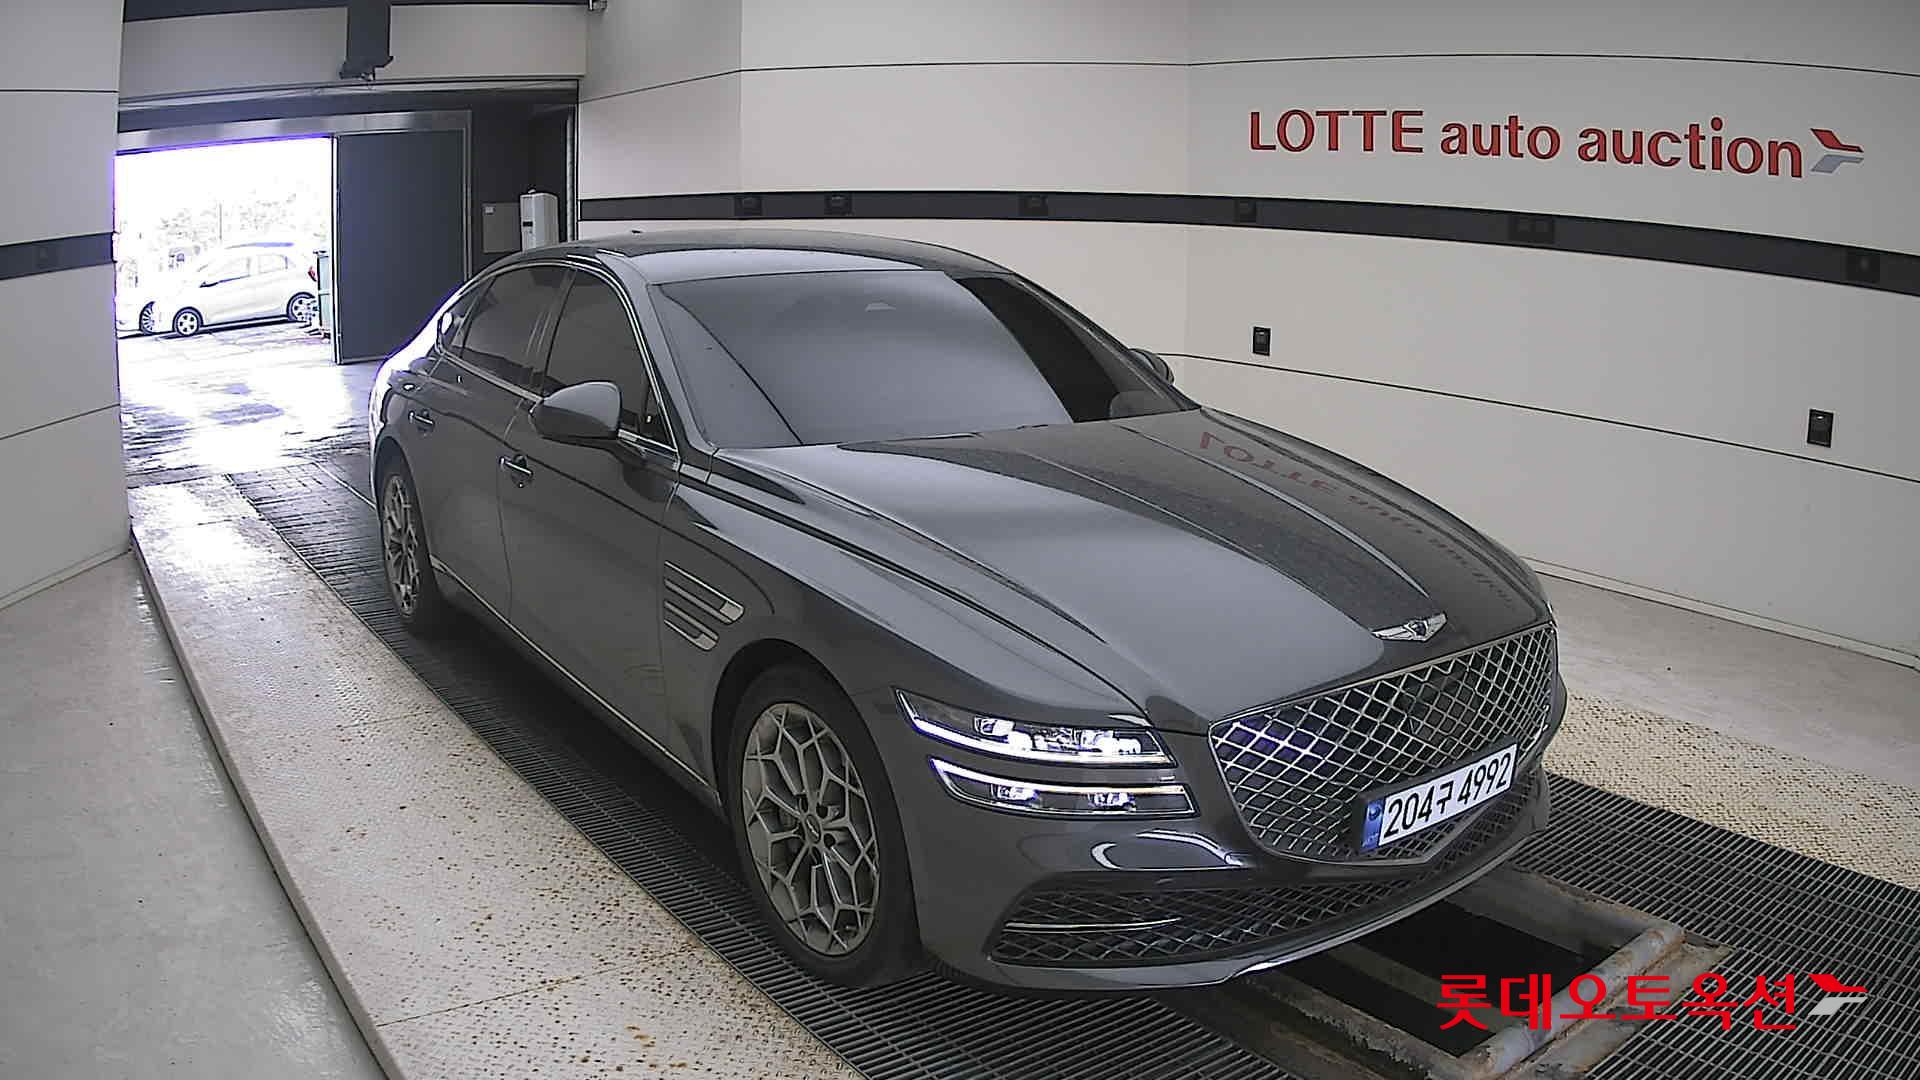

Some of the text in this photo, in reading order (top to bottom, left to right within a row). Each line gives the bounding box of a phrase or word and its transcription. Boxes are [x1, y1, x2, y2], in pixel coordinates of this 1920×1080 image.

[1249, 110, 1804, 179] LOTTE auto auction
[1383, 752, 1512, 839] 204구 4992
